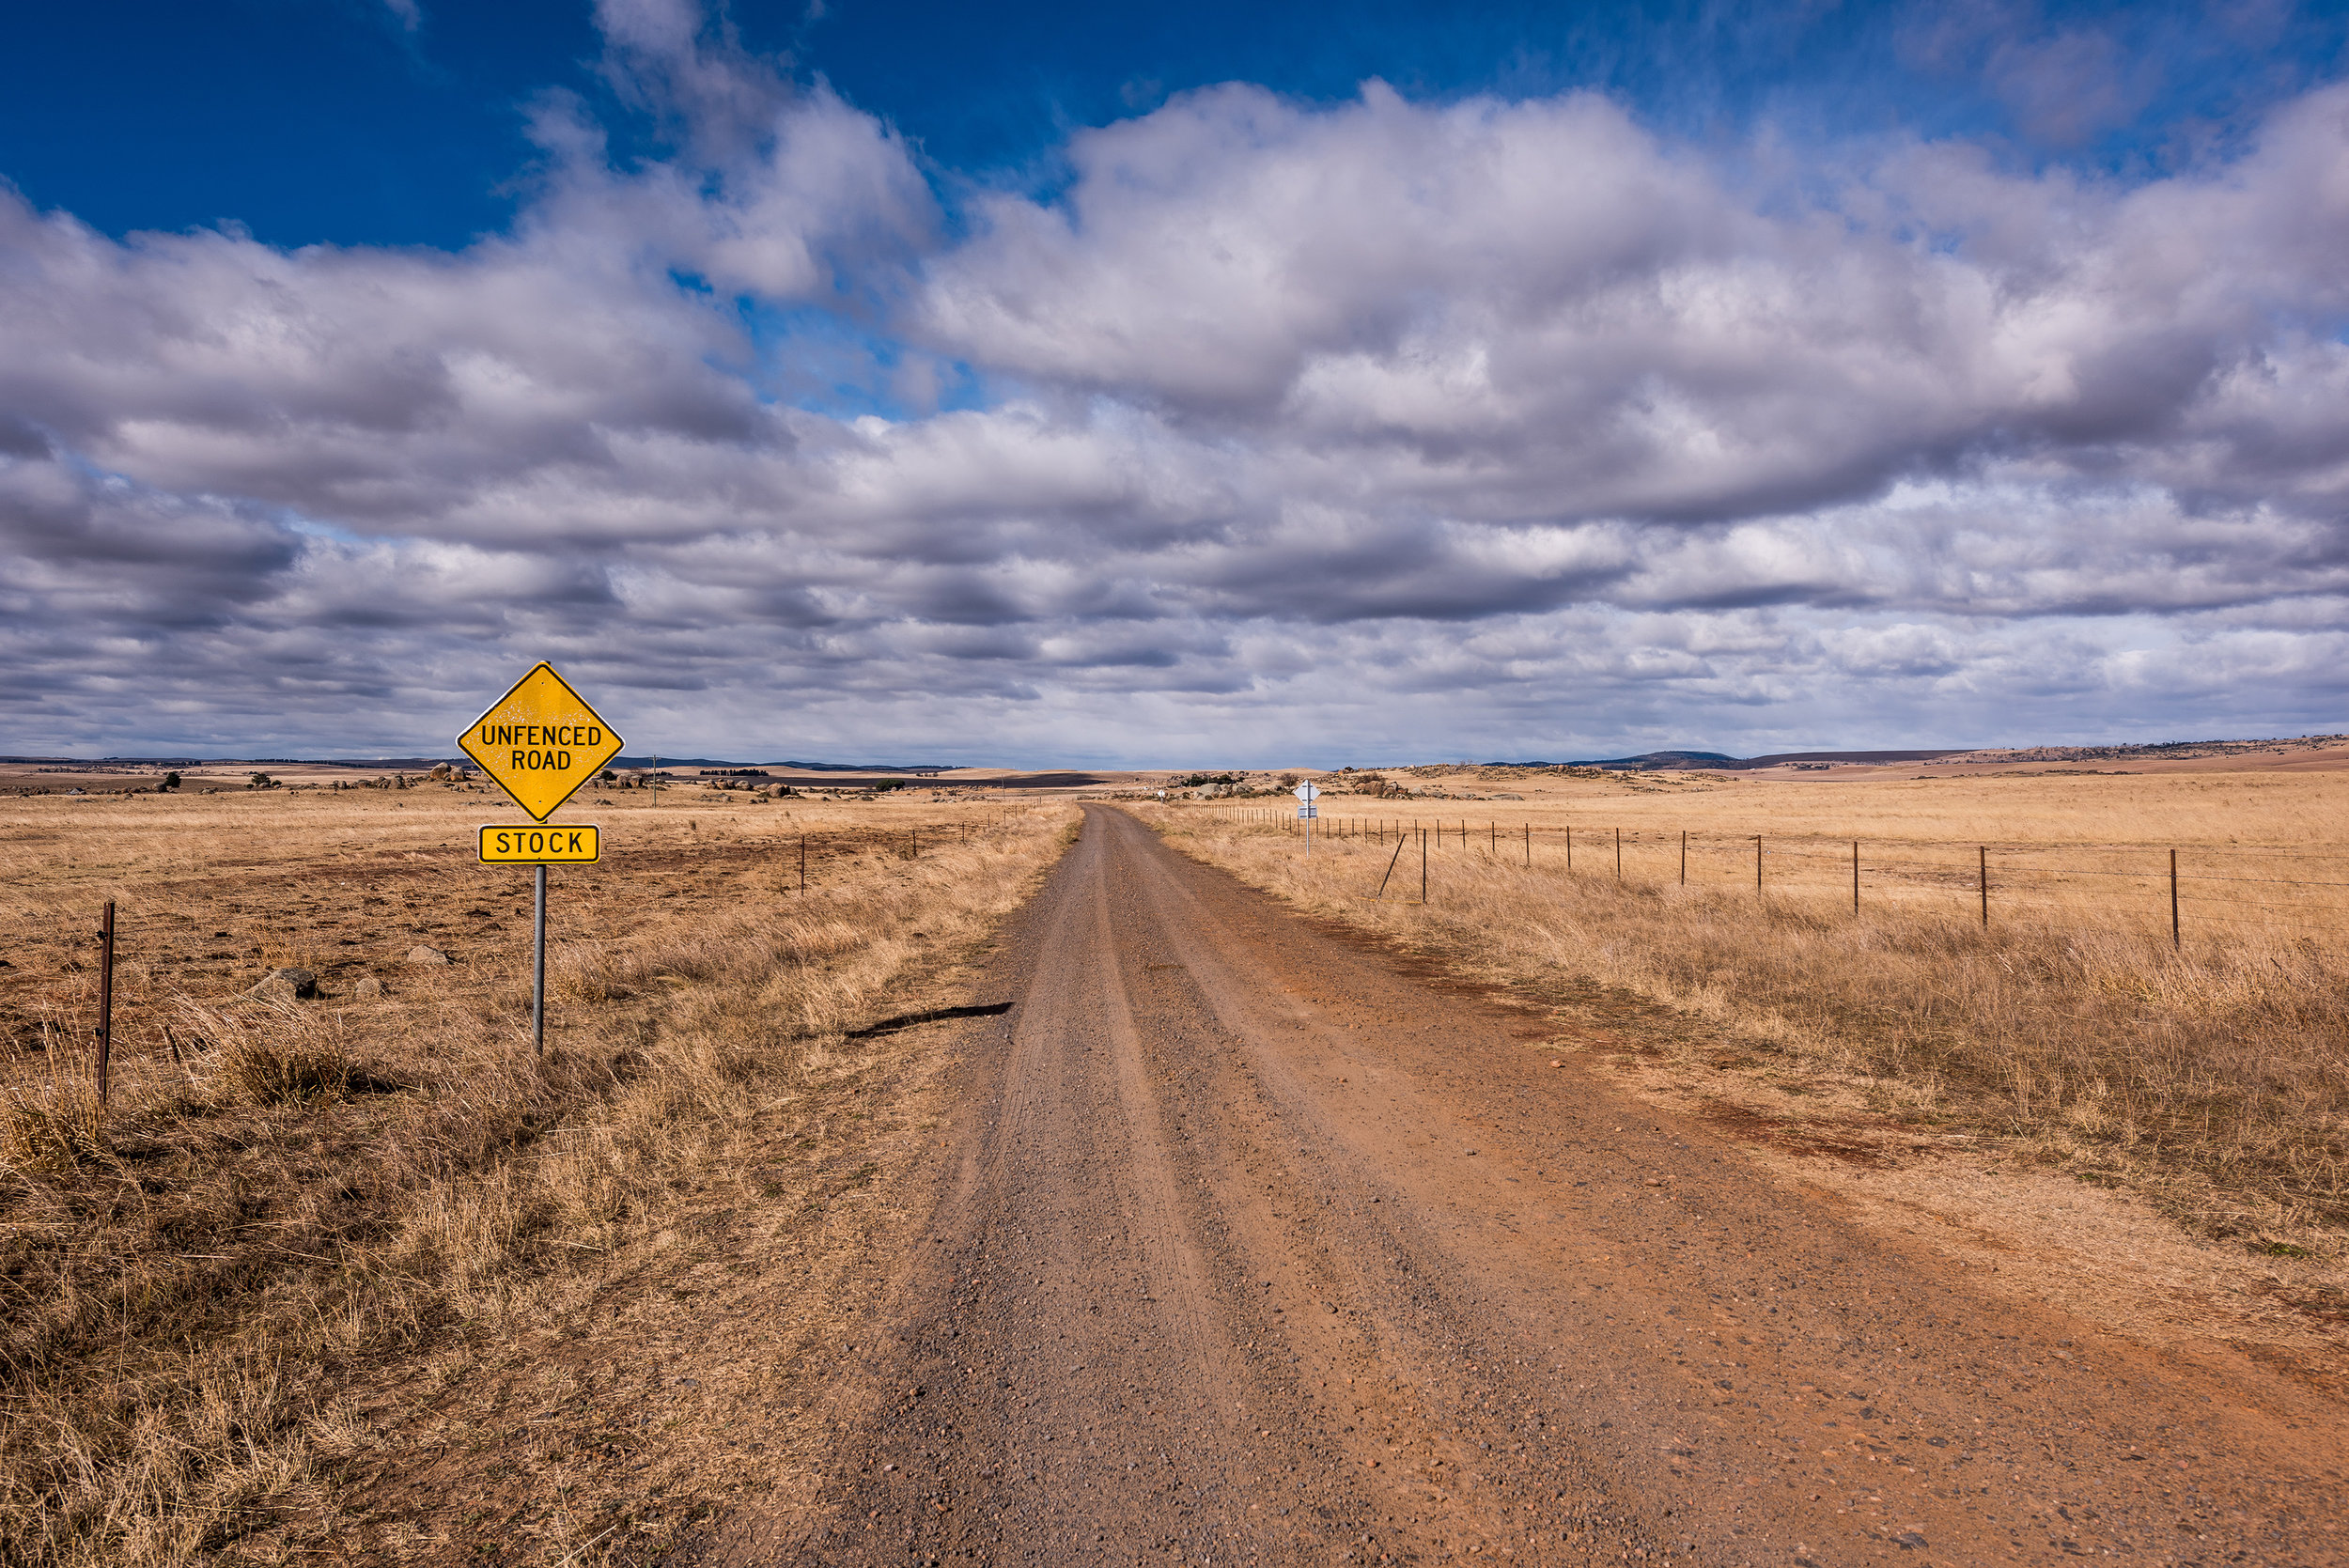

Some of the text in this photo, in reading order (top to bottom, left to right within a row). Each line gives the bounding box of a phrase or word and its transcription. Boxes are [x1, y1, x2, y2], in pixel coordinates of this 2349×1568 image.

[481, 725, 601, 746] UNFENCED
[512, 751, 570, 770] ROAD
[496, 832, 583, 853] STOCK
